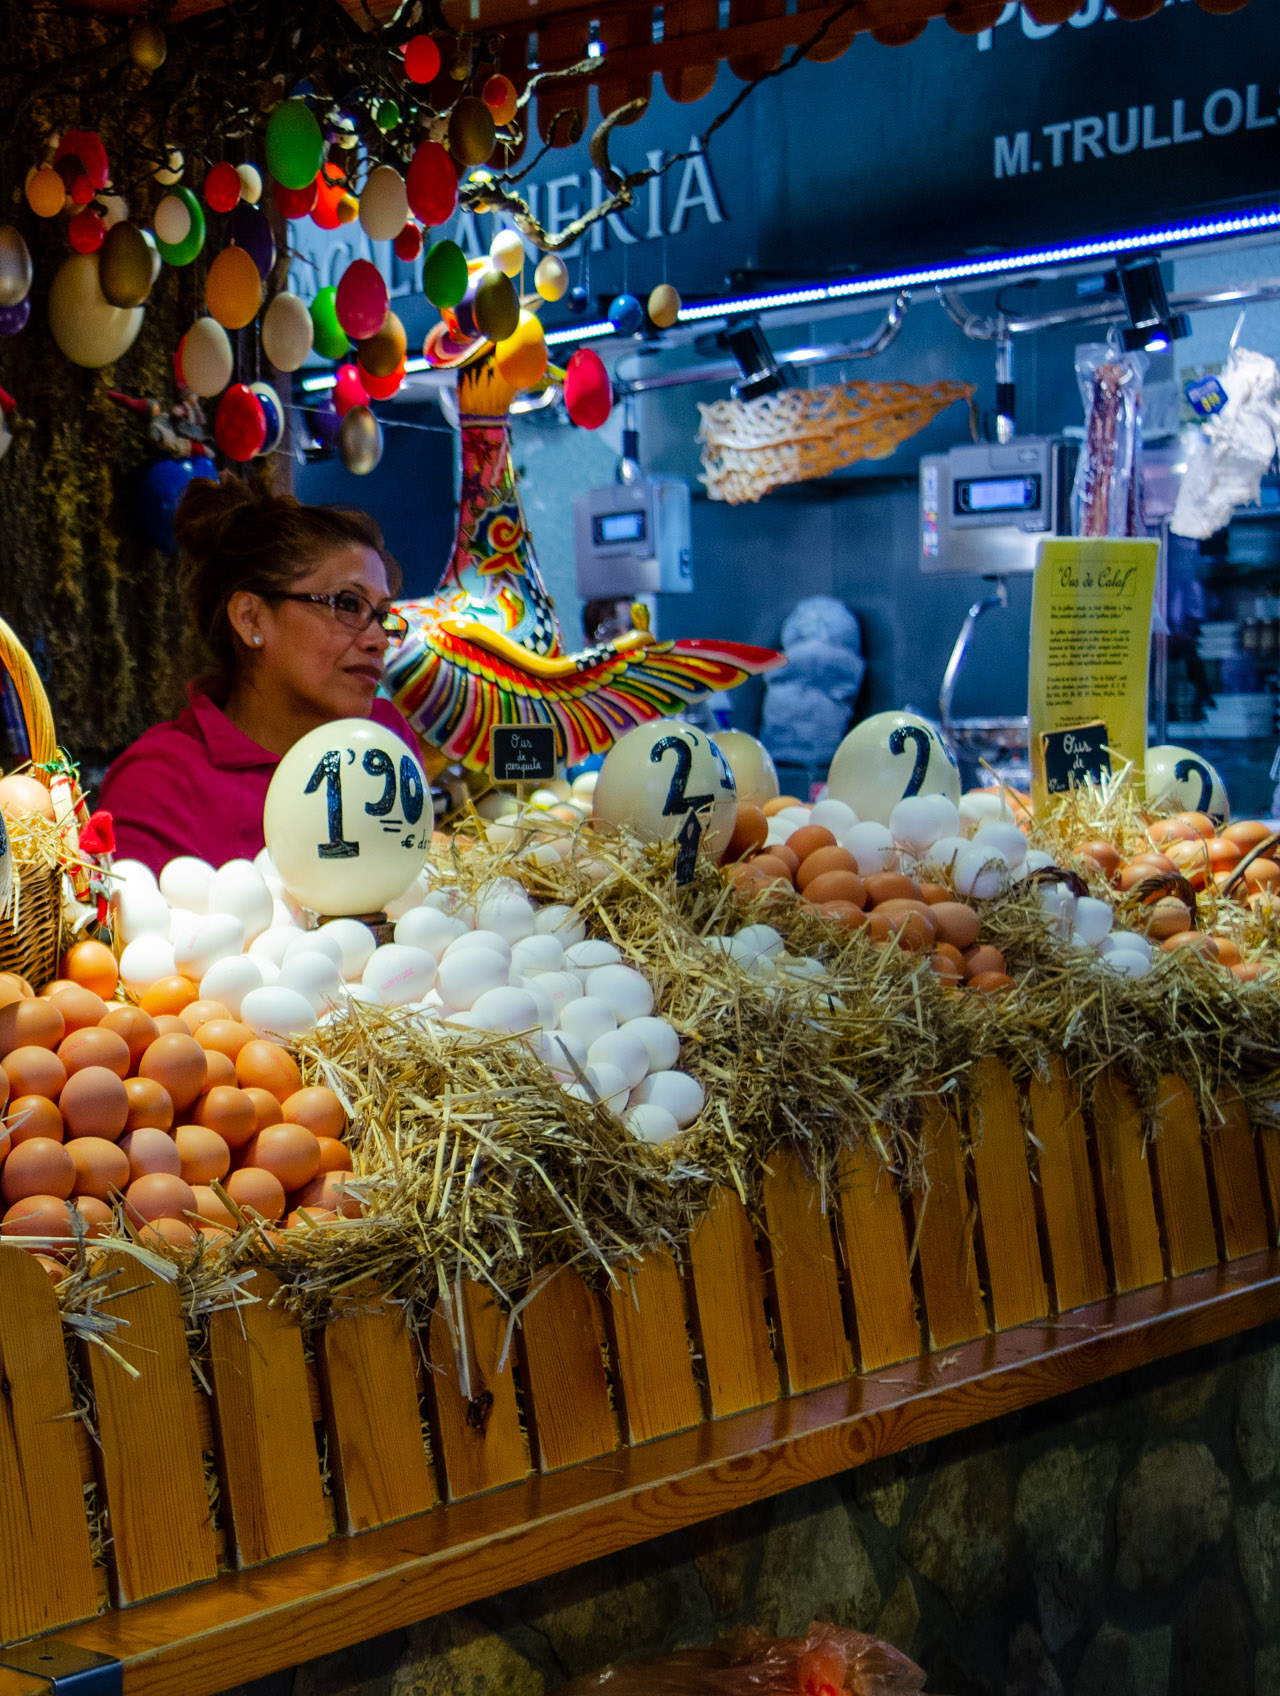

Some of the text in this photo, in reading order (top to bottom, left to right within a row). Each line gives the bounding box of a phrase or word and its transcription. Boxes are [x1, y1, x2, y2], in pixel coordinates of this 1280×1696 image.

[993, 83, 1280, 179] M.TRULLOL
[510, 733, 534, 749] Ous
[1063, 733, 1092, 755] Ous
[304, 748, 424, 859] 1'90
